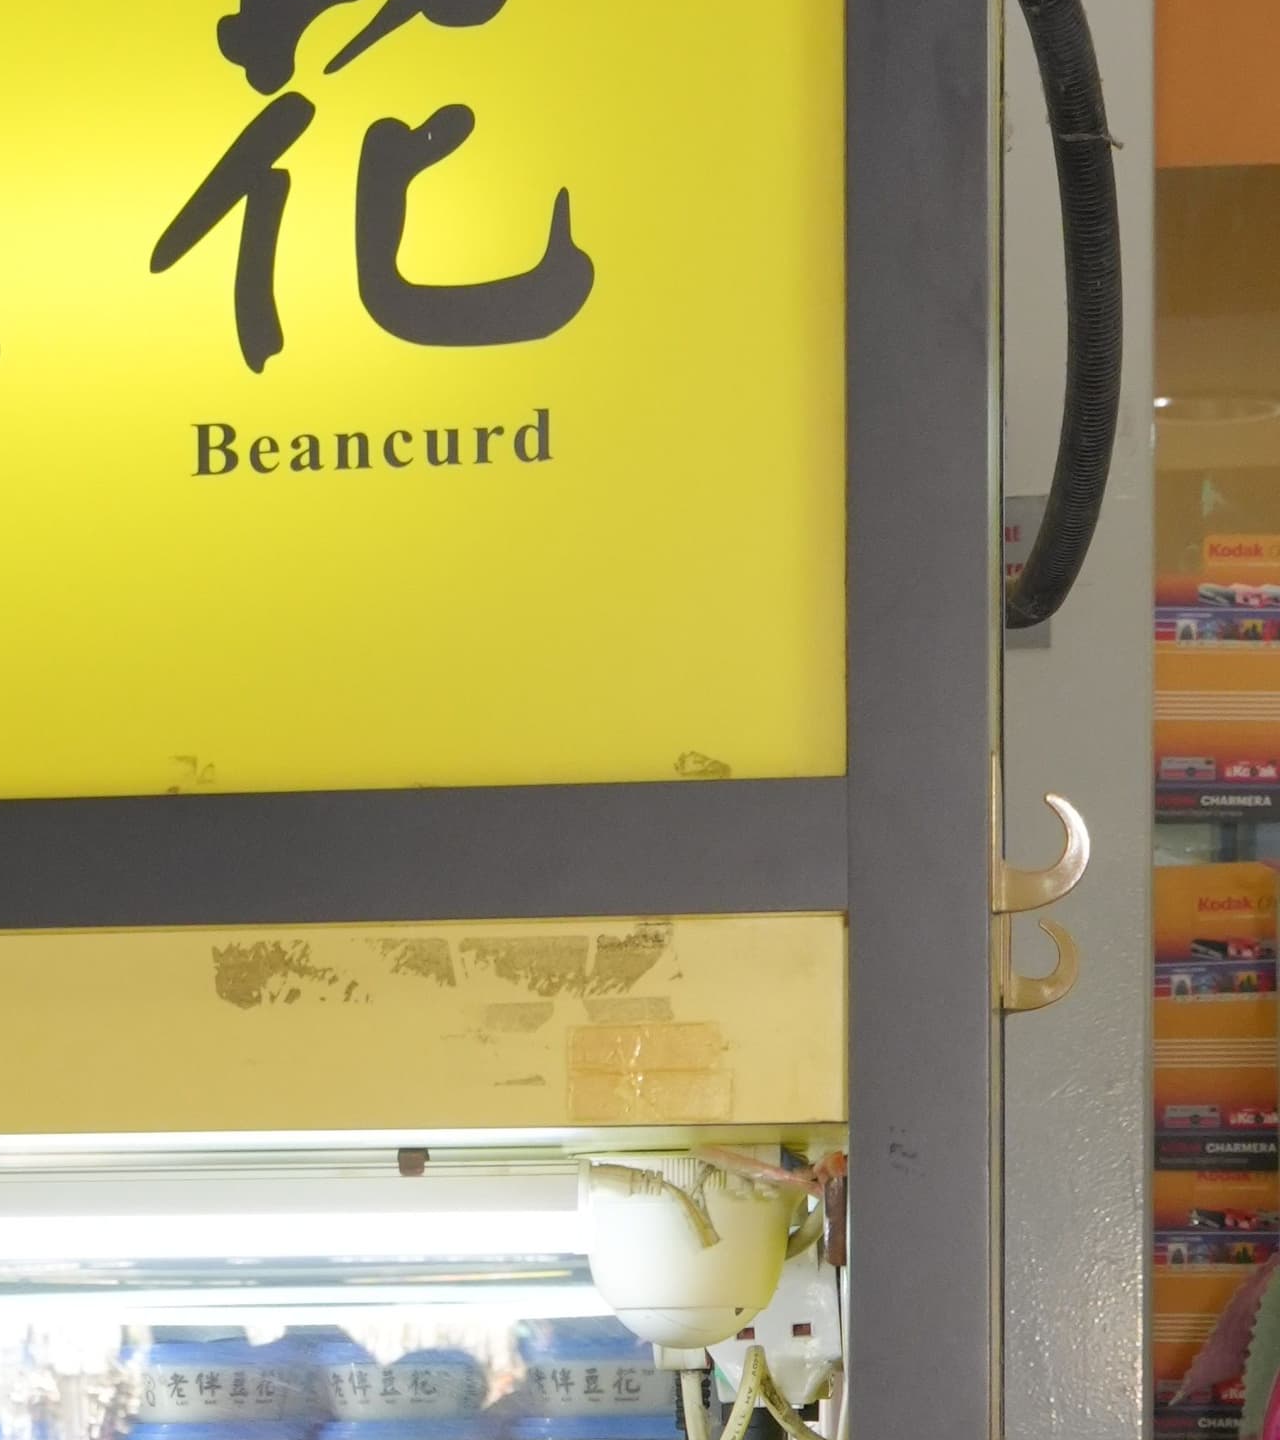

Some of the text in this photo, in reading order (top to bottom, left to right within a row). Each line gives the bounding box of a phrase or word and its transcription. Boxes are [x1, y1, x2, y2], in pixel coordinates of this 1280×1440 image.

[190, 408, 555, 479] Beancurd
[1208, 543, 1263, 558] Kodak
[1200, 795, 1272, 807] CHARMERA
